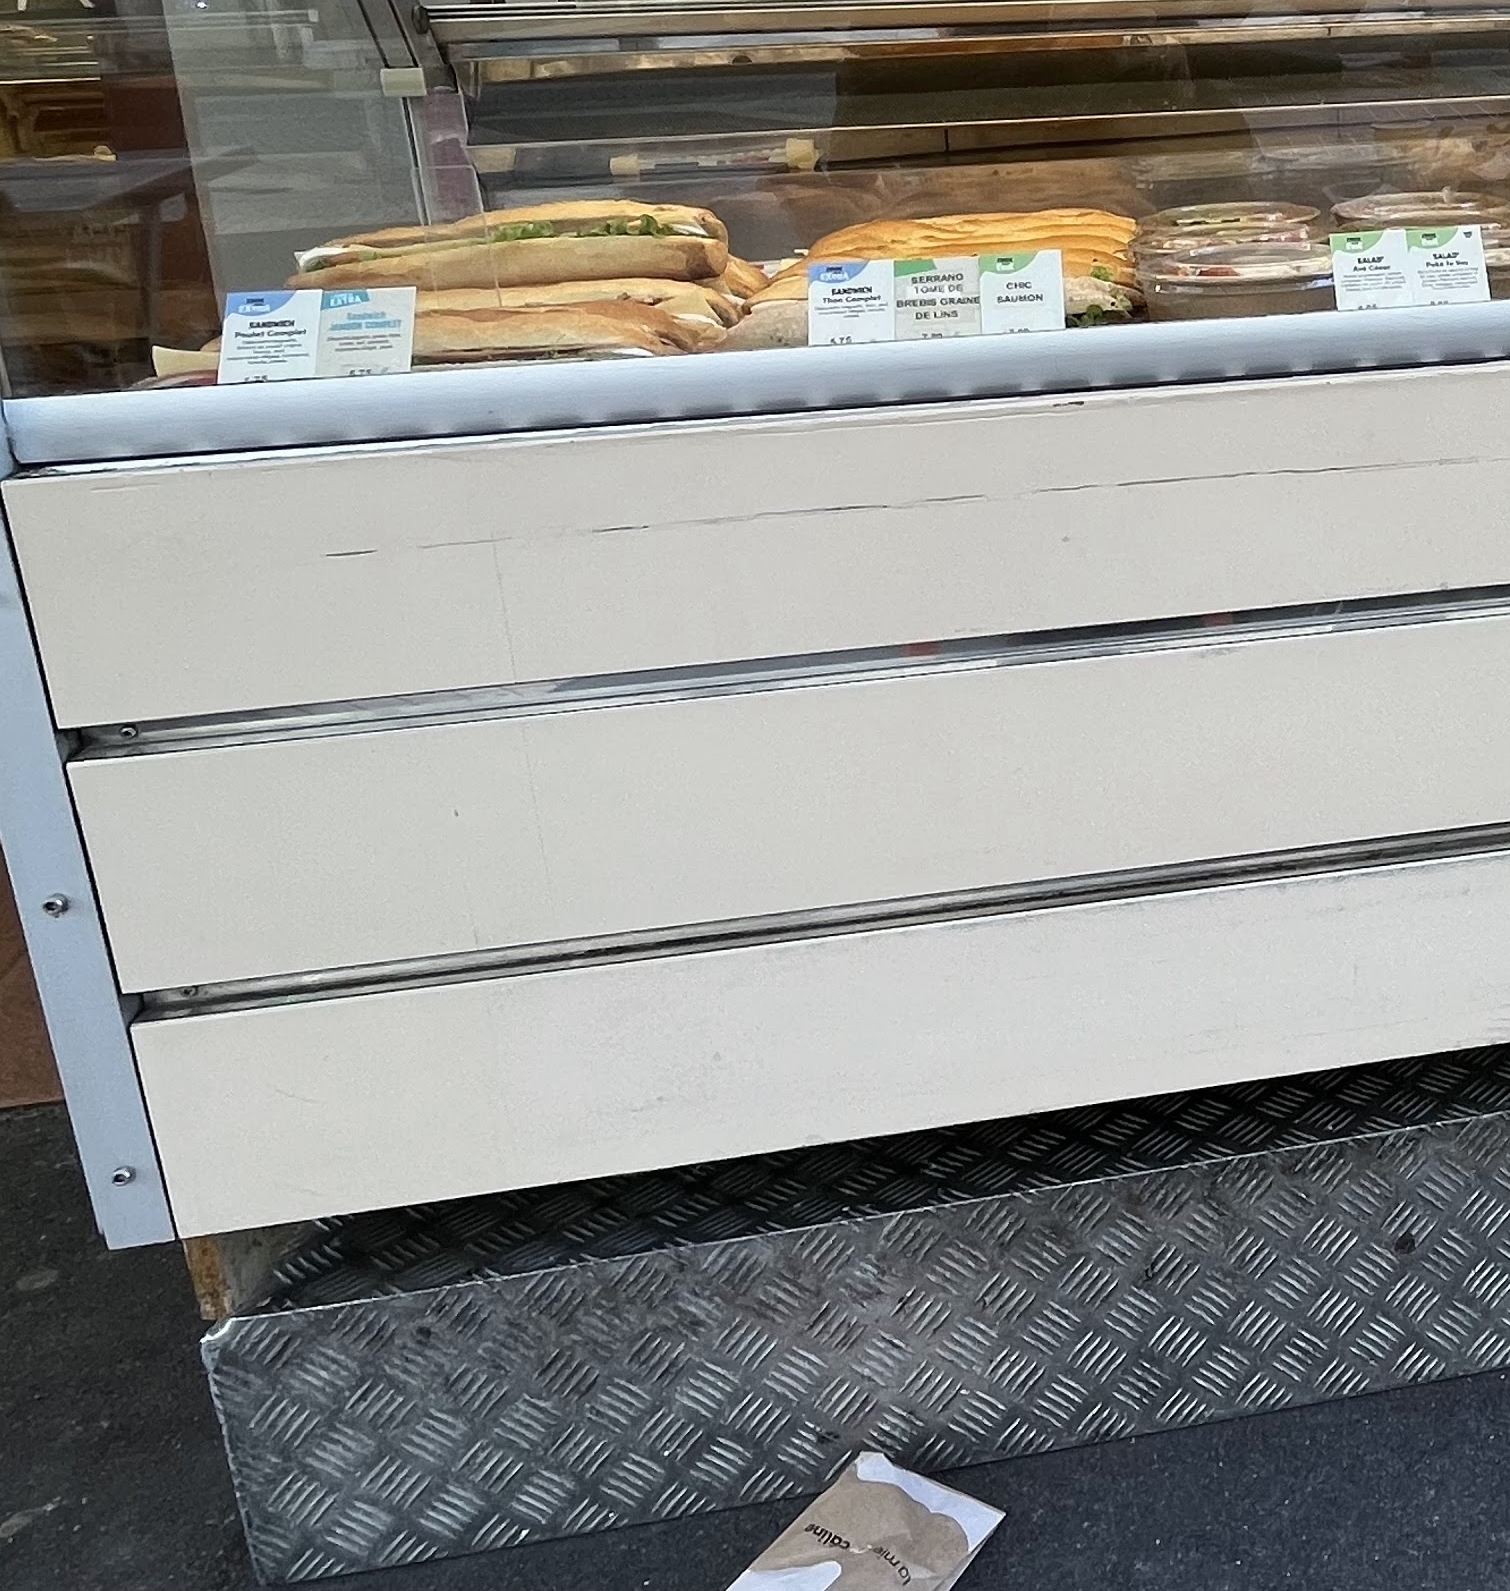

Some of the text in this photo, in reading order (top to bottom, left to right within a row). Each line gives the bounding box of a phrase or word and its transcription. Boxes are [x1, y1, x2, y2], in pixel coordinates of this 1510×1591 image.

[911, 273, 964, 284] SERRANO
[948, 284, 963, 293] DE
[896, 297, 937, 308] BREBIS
[997, 294, 1043, 304] SAUMON
[915, 311, 931, 320] DE
